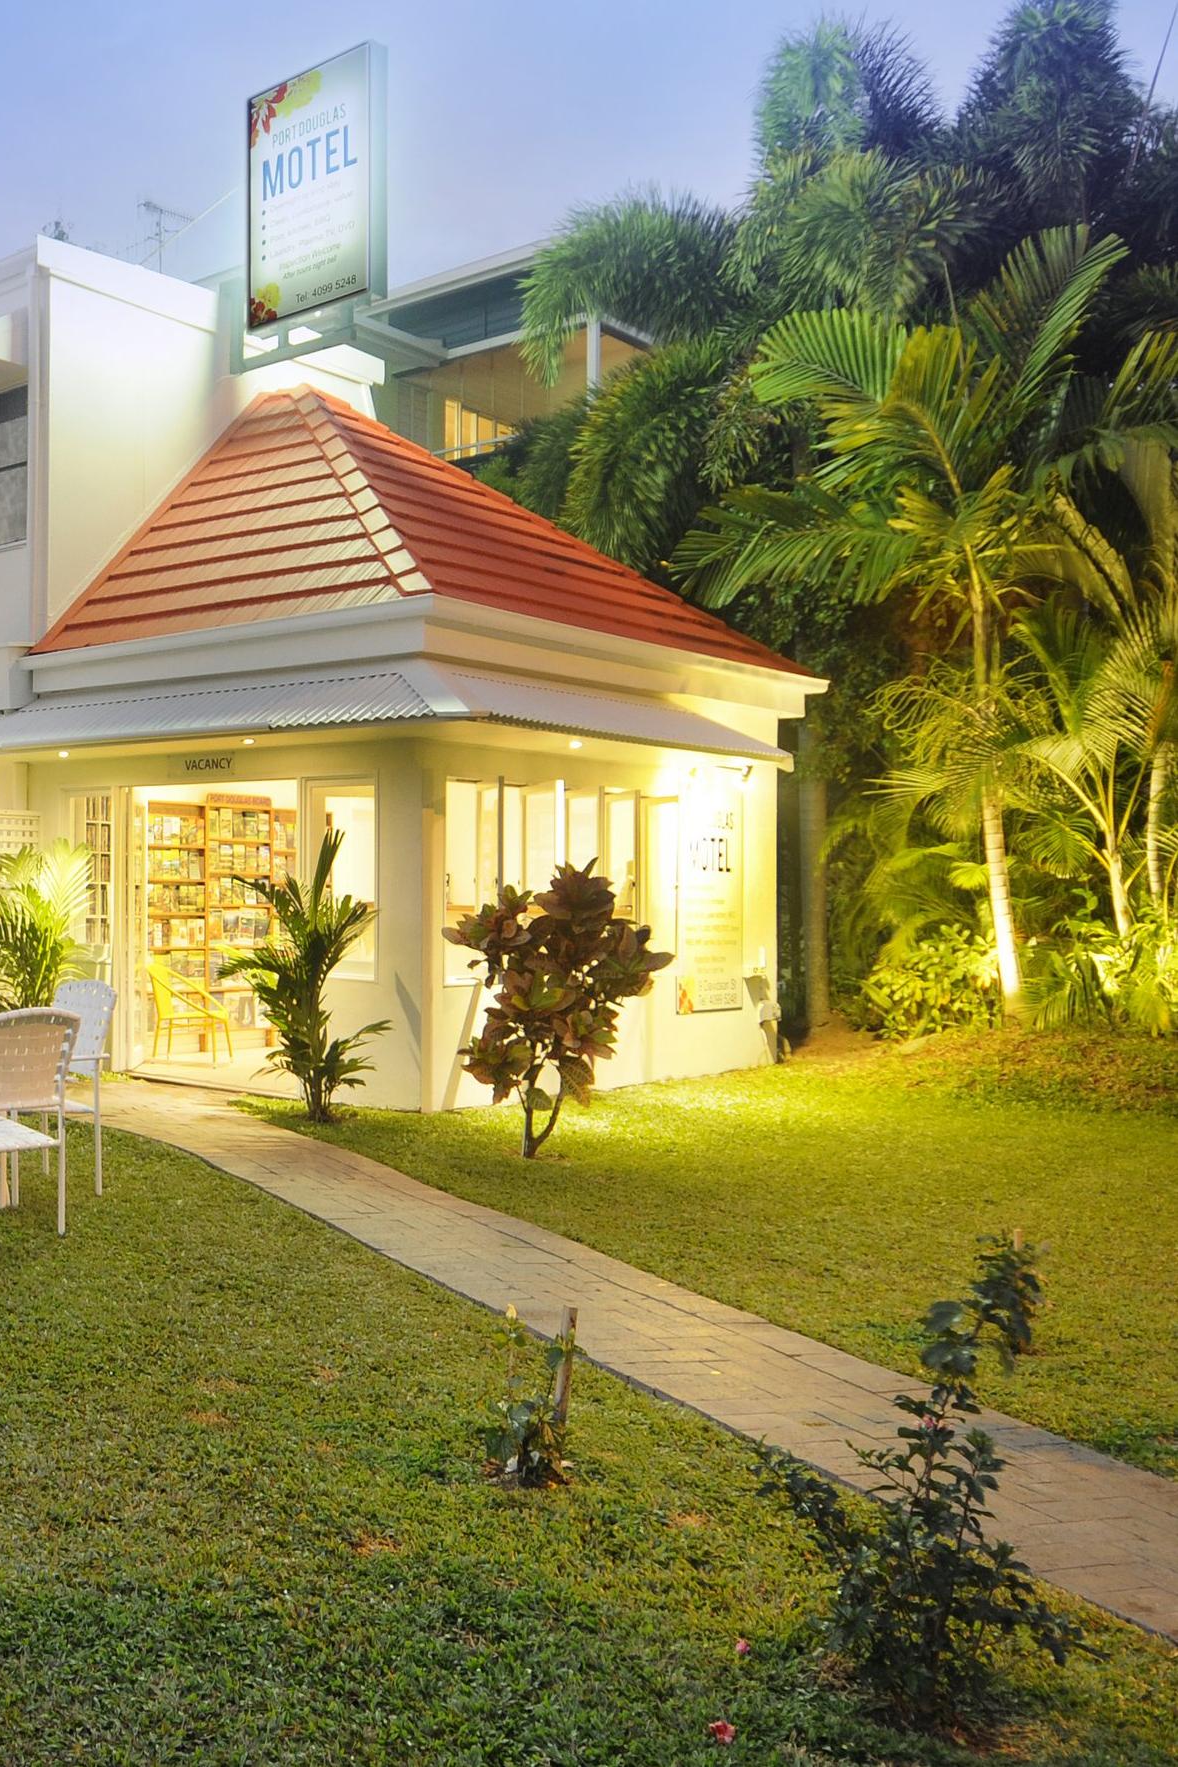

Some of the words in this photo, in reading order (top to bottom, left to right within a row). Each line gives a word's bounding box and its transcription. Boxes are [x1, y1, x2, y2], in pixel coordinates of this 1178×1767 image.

[272, 122, 298, 146] PORT
[299, 103, 347, 136] DOUGLAS
[262, 124, 358, 201] MOTEL
[296, 291, 310, 303] Tel:
[312, 281, 333, 298] 4099
[335, 274, 357, 290] 5248
[185, 757, 233, 771] VACANCY
